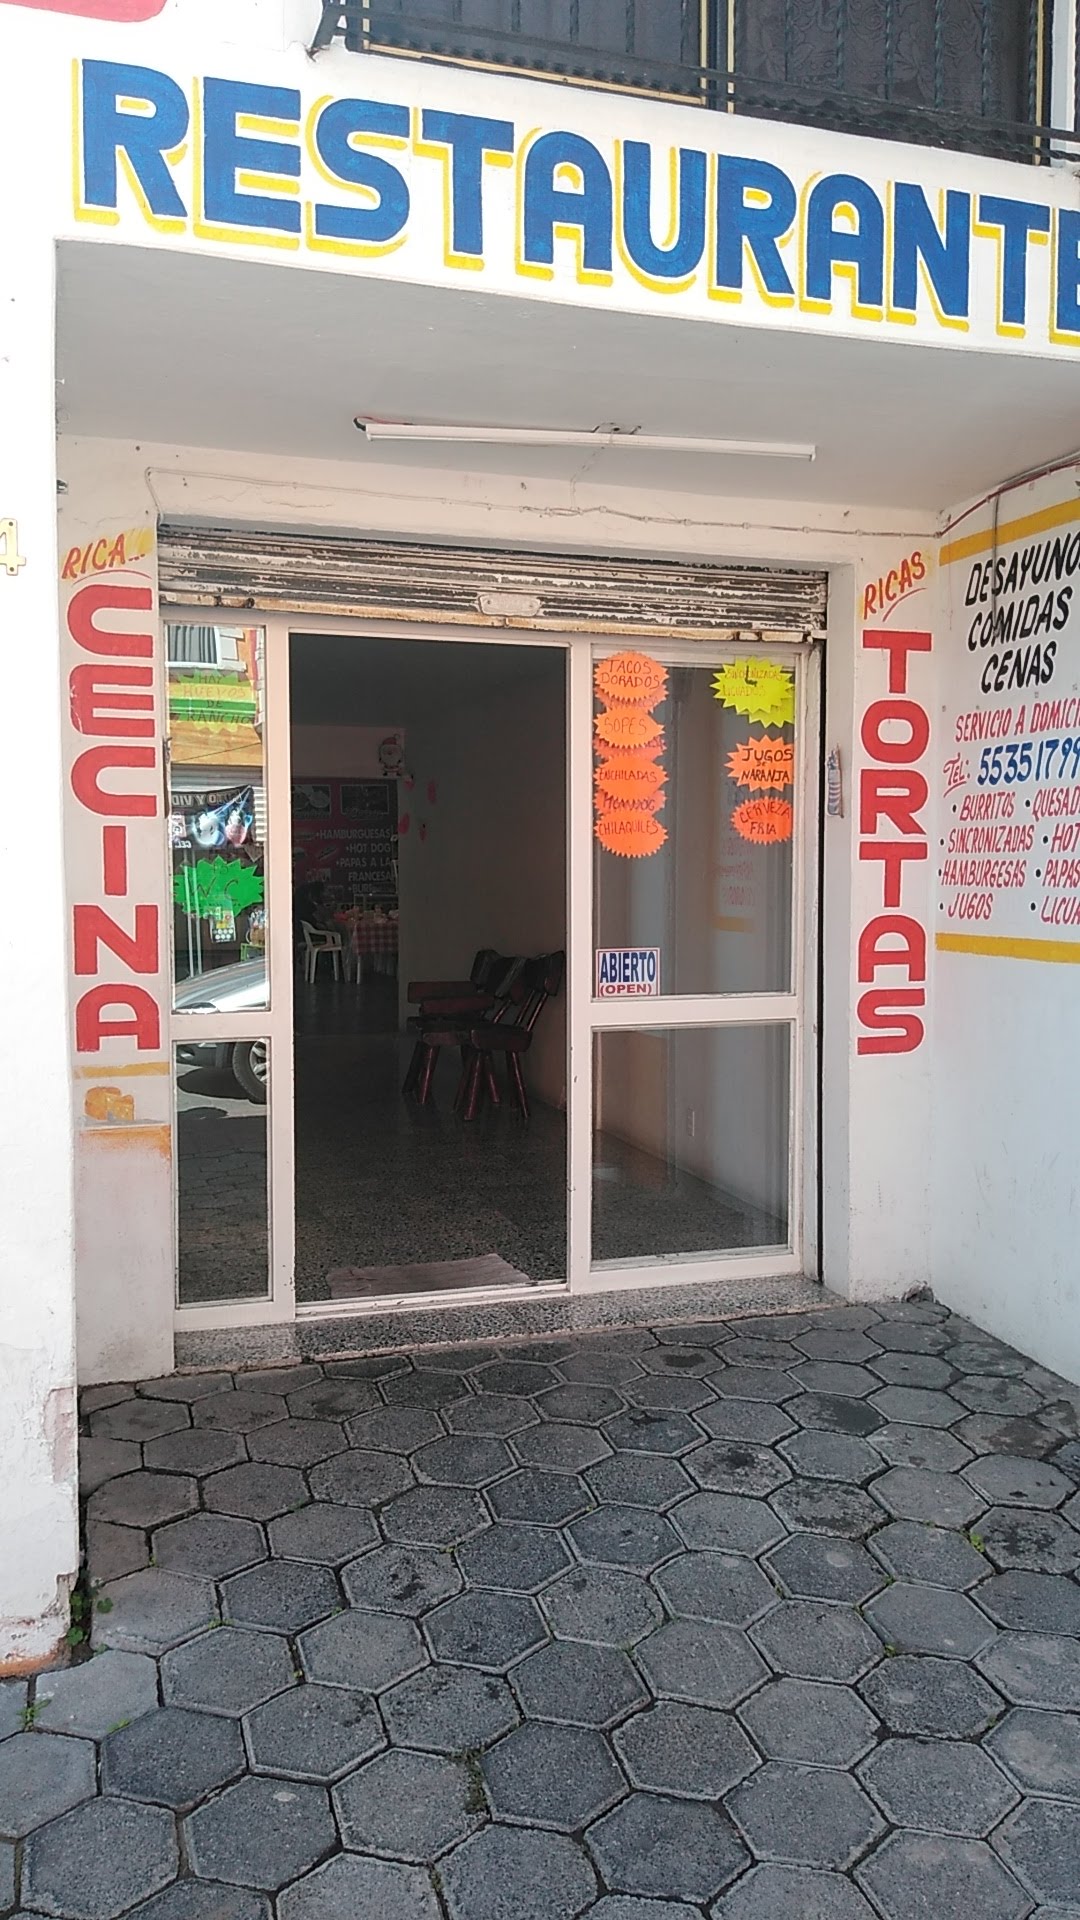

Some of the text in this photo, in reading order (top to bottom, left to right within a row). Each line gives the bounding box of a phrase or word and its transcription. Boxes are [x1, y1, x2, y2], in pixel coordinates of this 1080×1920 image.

[965, 531, 1080, 607] DESAYUNO
[863, 550, 926, 621] RICAS
[968, 586, 1073, 651] COMIDAS
[609, 659, 652, 674] TACOS
[981, 641, 1057, 694] CENAS
[601, 673, 660, 689] DORADOS
[604, 717, 647, 736] SOPES
[956, 696, 1080, 742] SERVICIO A DOMICI
[742, 747, 794, 763] JUGOS
[599, 770, 658, 784] ENCHILADAS
[741, 769, 790, 783] NARANJA
[740, 800, 792, 823] CERVEZA
[960, 791, 1016, 821] BURRITOS
[1033, 785, 1080, 822] QUESAD
[66, 583, 162, 1052] CECINA
[599, 820, 659, 836] CHILAQUILES
[750, 821, 777, 836] FRIA
[319, 829, 391, 840] HAMBURGUESAS
[856, 629, 932, 1056] TORTAS
[948, 824, 1035, 854] SINCRONIZADAS
[349, 843, 391, 853] HOT DOG
[340, 857, 367, 868] PAPAS
[370, 857, 377, 867] A
[941, 859, 1028, 889] HAMBURGESAS
[948, 893, 993, 920] JUGOS
[600, 951, 656, 983] ABIERTO
[600, 984, 652, 996] (OPEN)
